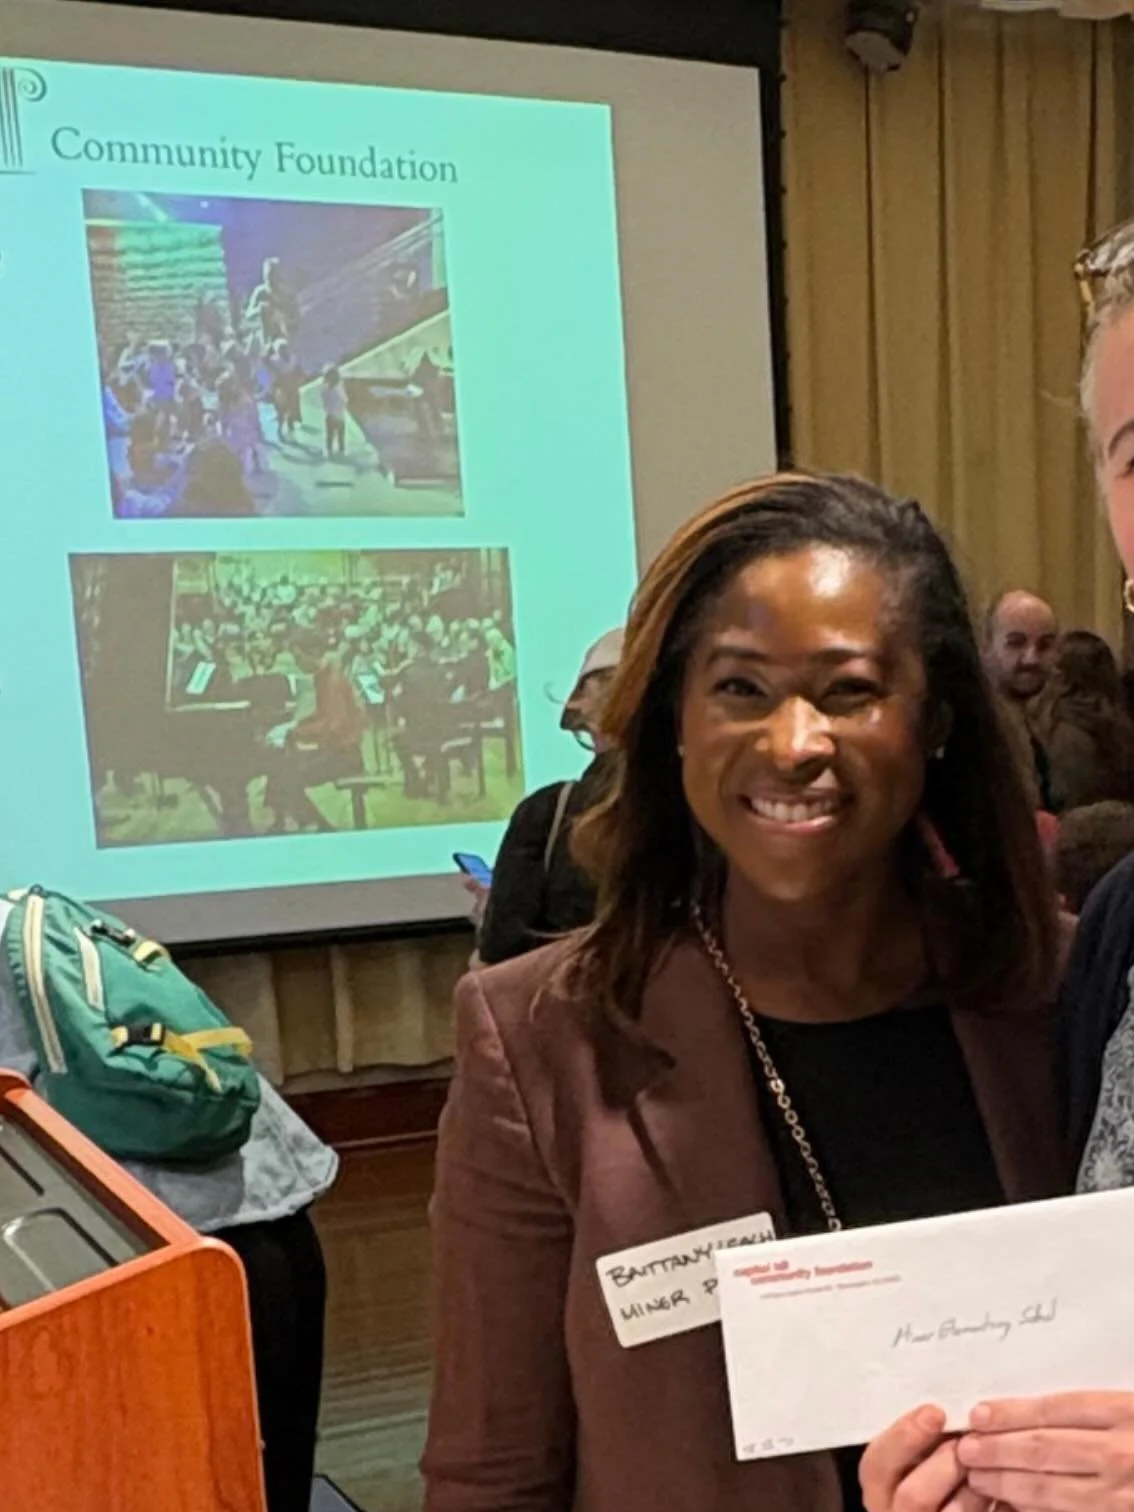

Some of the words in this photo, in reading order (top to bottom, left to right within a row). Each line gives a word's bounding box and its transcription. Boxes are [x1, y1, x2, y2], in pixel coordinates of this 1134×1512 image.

[51, 126, 262, 180] Community
[275, 141, 458, 183] Foundation
[605, 1240, 712, 1288] BRITTANY
[619, 1289, 690, 1321] MINER
